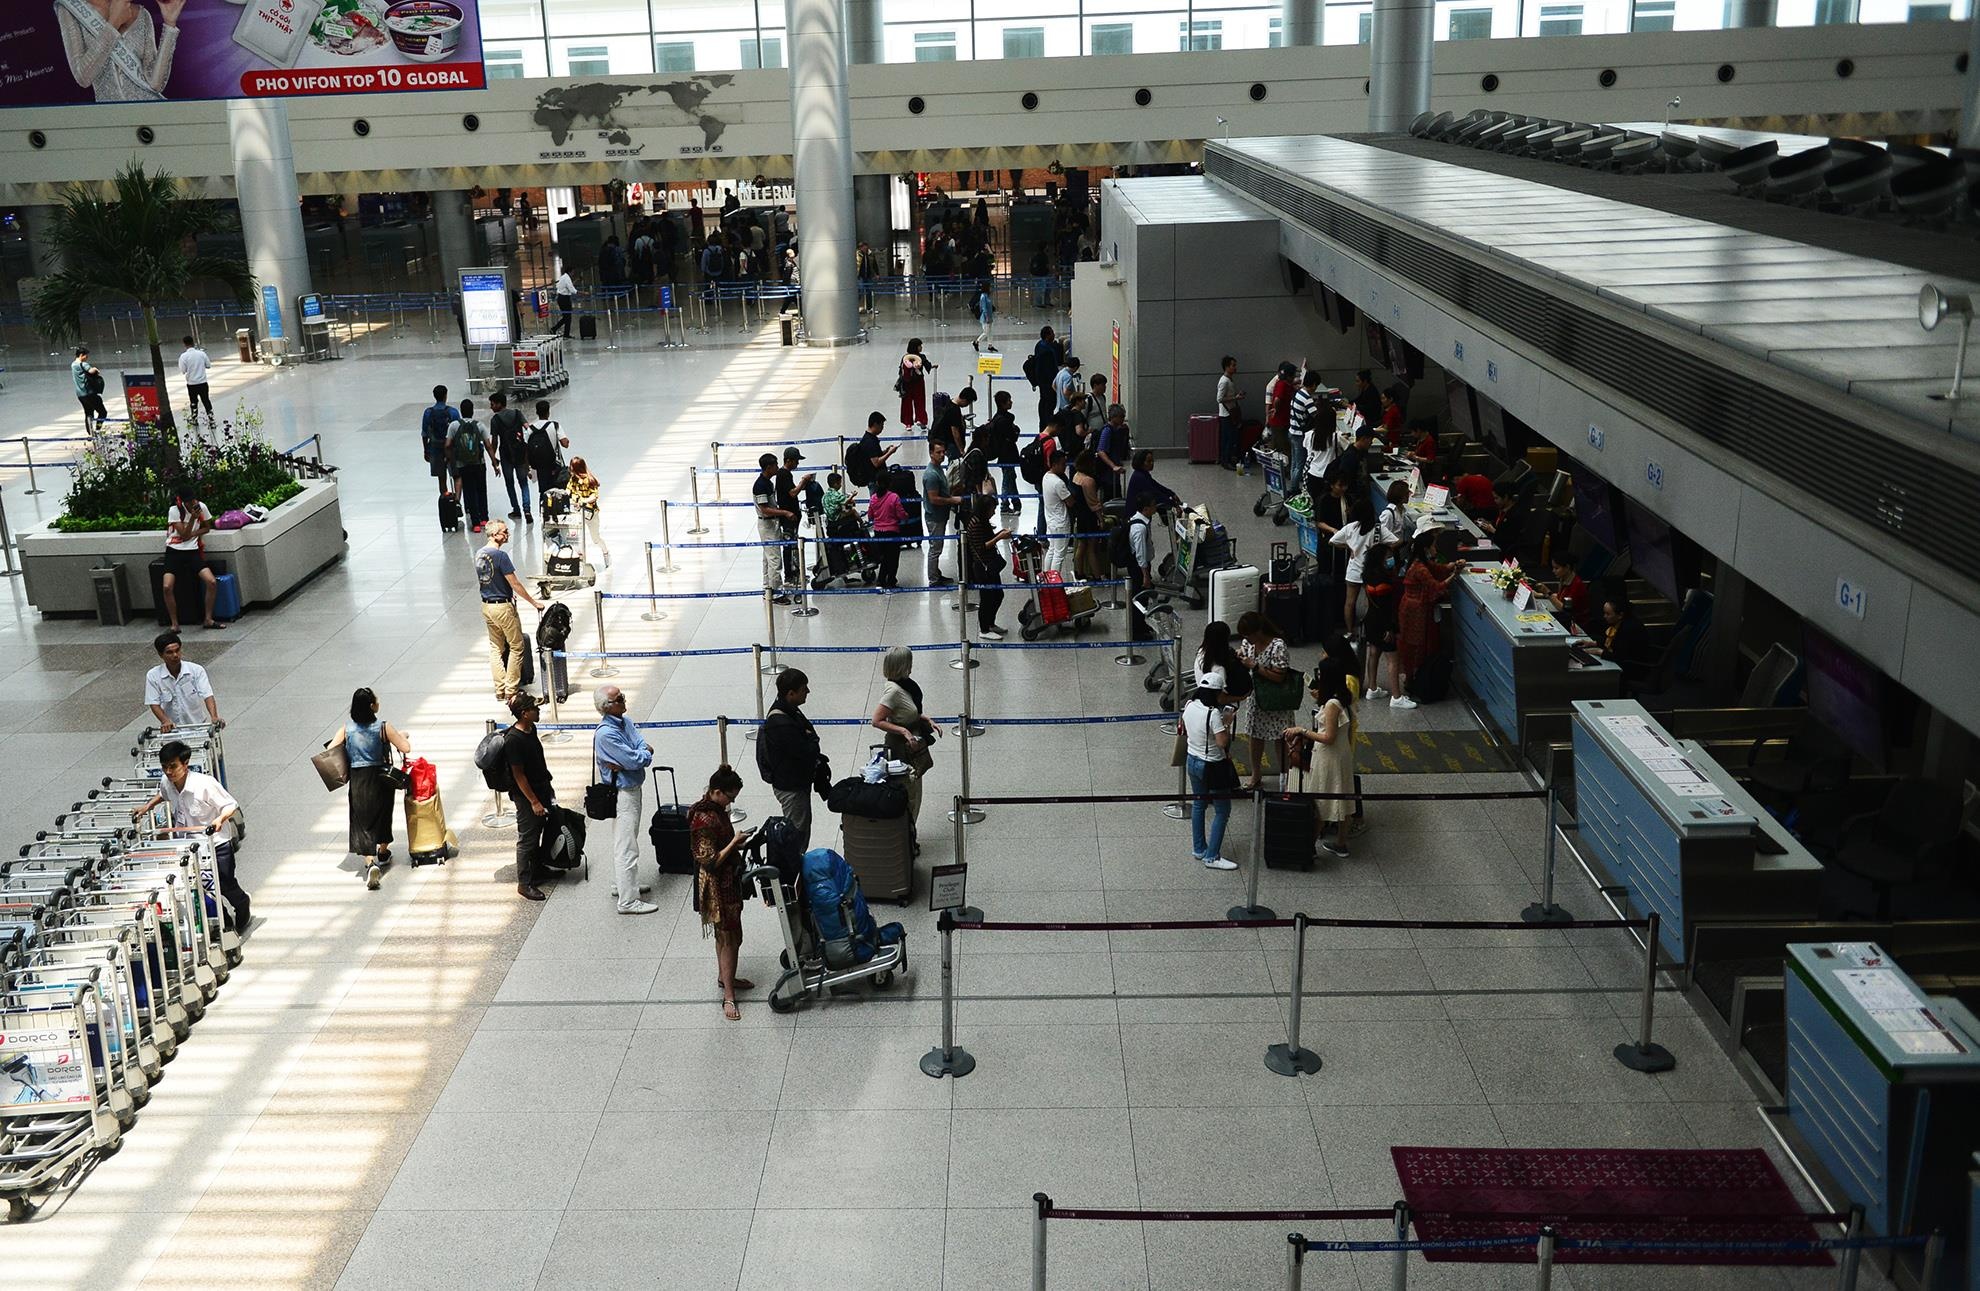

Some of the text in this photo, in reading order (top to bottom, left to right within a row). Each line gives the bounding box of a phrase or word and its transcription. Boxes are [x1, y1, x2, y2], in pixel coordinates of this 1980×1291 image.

[256, 69, 468, 91] PHO VIFON TOP 10 GLOBAL
[1648, 463, 1661, 485] G-2
[1840, 583, 1861, 613] G-1
[8, 1034, 58, 1043] DORCO
[47, 1065, 82, 1073] DORCO
[1325, 1242, 1350, 1250] TIA
